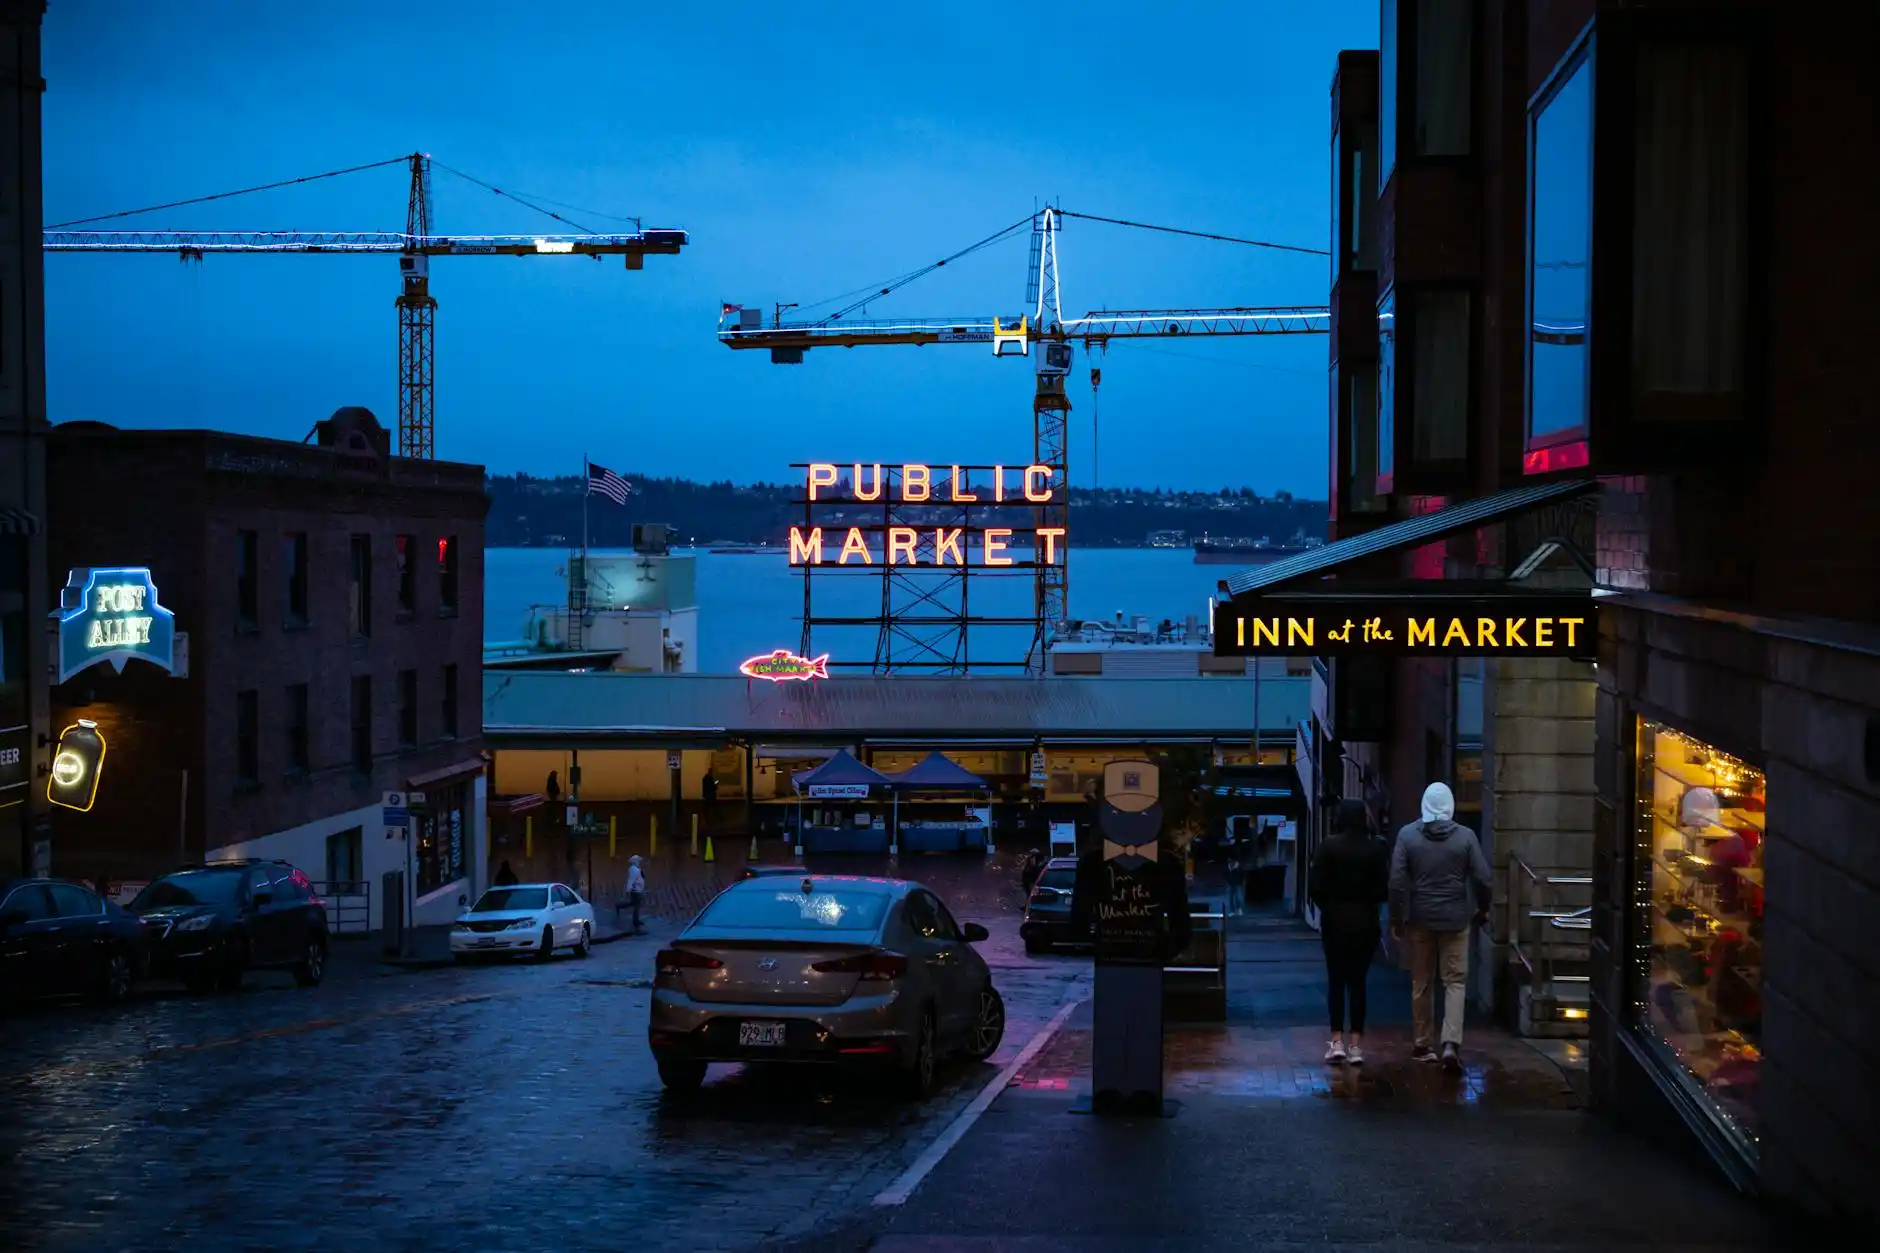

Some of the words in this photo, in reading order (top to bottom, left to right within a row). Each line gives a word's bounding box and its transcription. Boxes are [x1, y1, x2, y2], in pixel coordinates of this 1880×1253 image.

[809, 463, 1053, 502] PUBLIC
[789, 526, 1066, 565] MARKET
[96, 585, 147, 612] POST
[87, 617, 153, 648] ALLEY
[1237, 617, 1315, 646] INN
[1327, 618, 1355, 643] at
[1362, 617, 1394, 643] the
[1407, 617, 1585, 647] MARKET
[1107, 864, 1135, 890] Inn
[1112, 886, 1128, 901] at
[1131, 884, 1151, 900] the
[1098, 901, 1161, 920] Market
